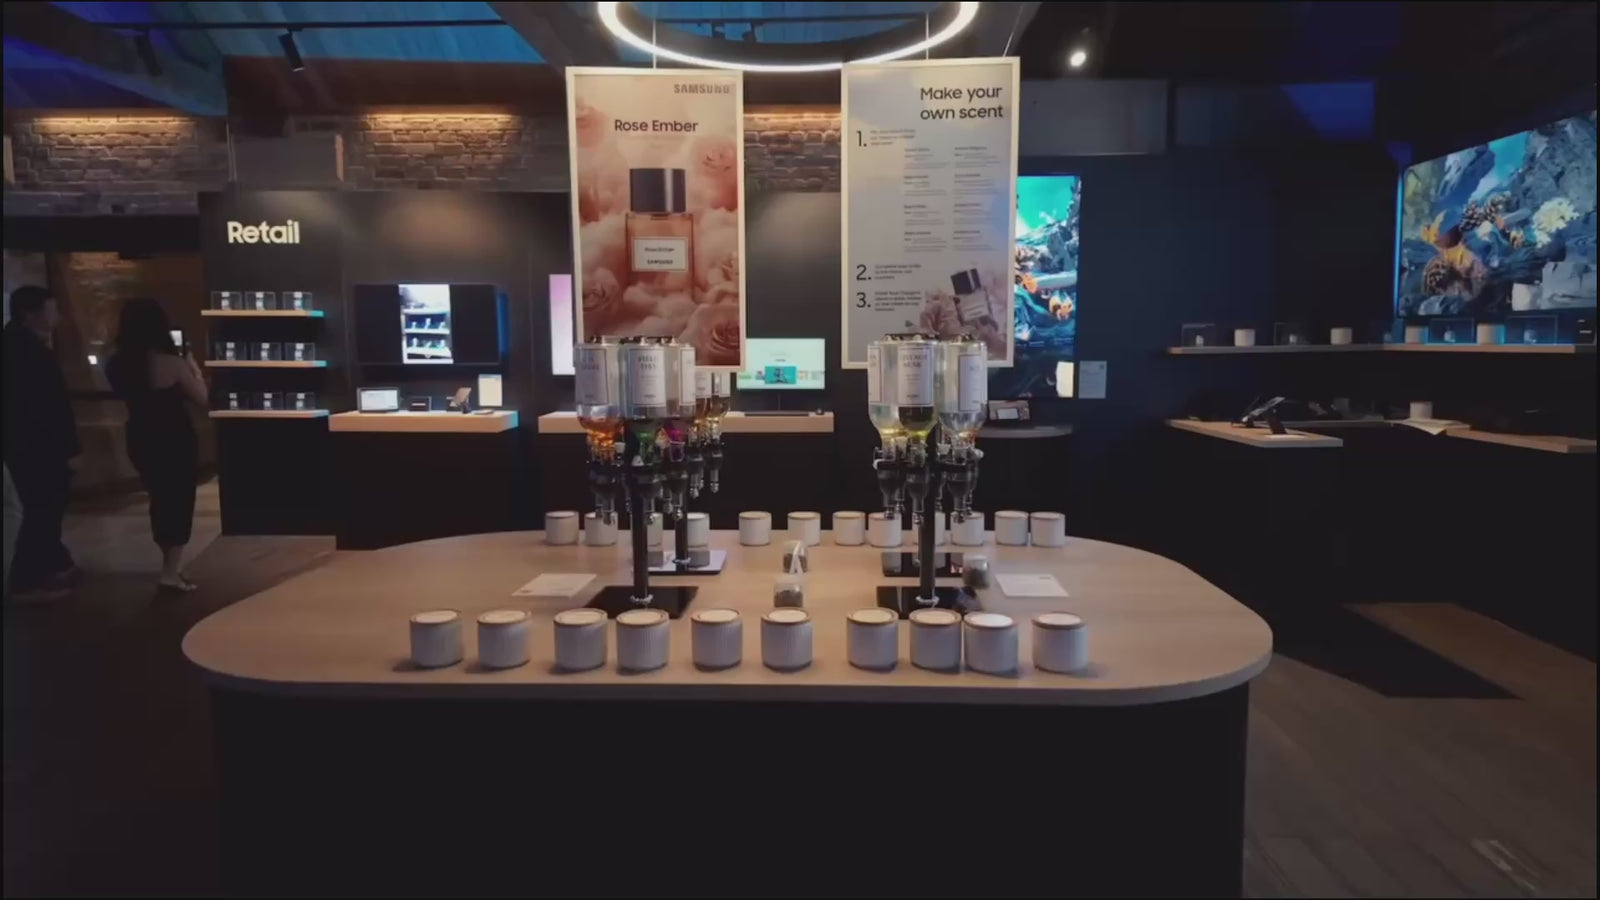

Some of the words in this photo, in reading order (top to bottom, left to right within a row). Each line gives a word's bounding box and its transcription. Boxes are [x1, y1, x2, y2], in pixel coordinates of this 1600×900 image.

[673, 83, 730, 94] SAMSUNG
[920, 87, 963, 100] Make
[967, 87, 1003, 103] your
[920, 108, 956, 120] own
[959, 105, 1004, 119] scent
[614, 119, 649, 132] Rose
[652, 119, 699, 132] Ember
[856, 130, 867, 147] 1.
[227, 219, 300, 244] Retail
[856, 264, 872, 281] 2.
[856, 292, 871, 308] 3.
